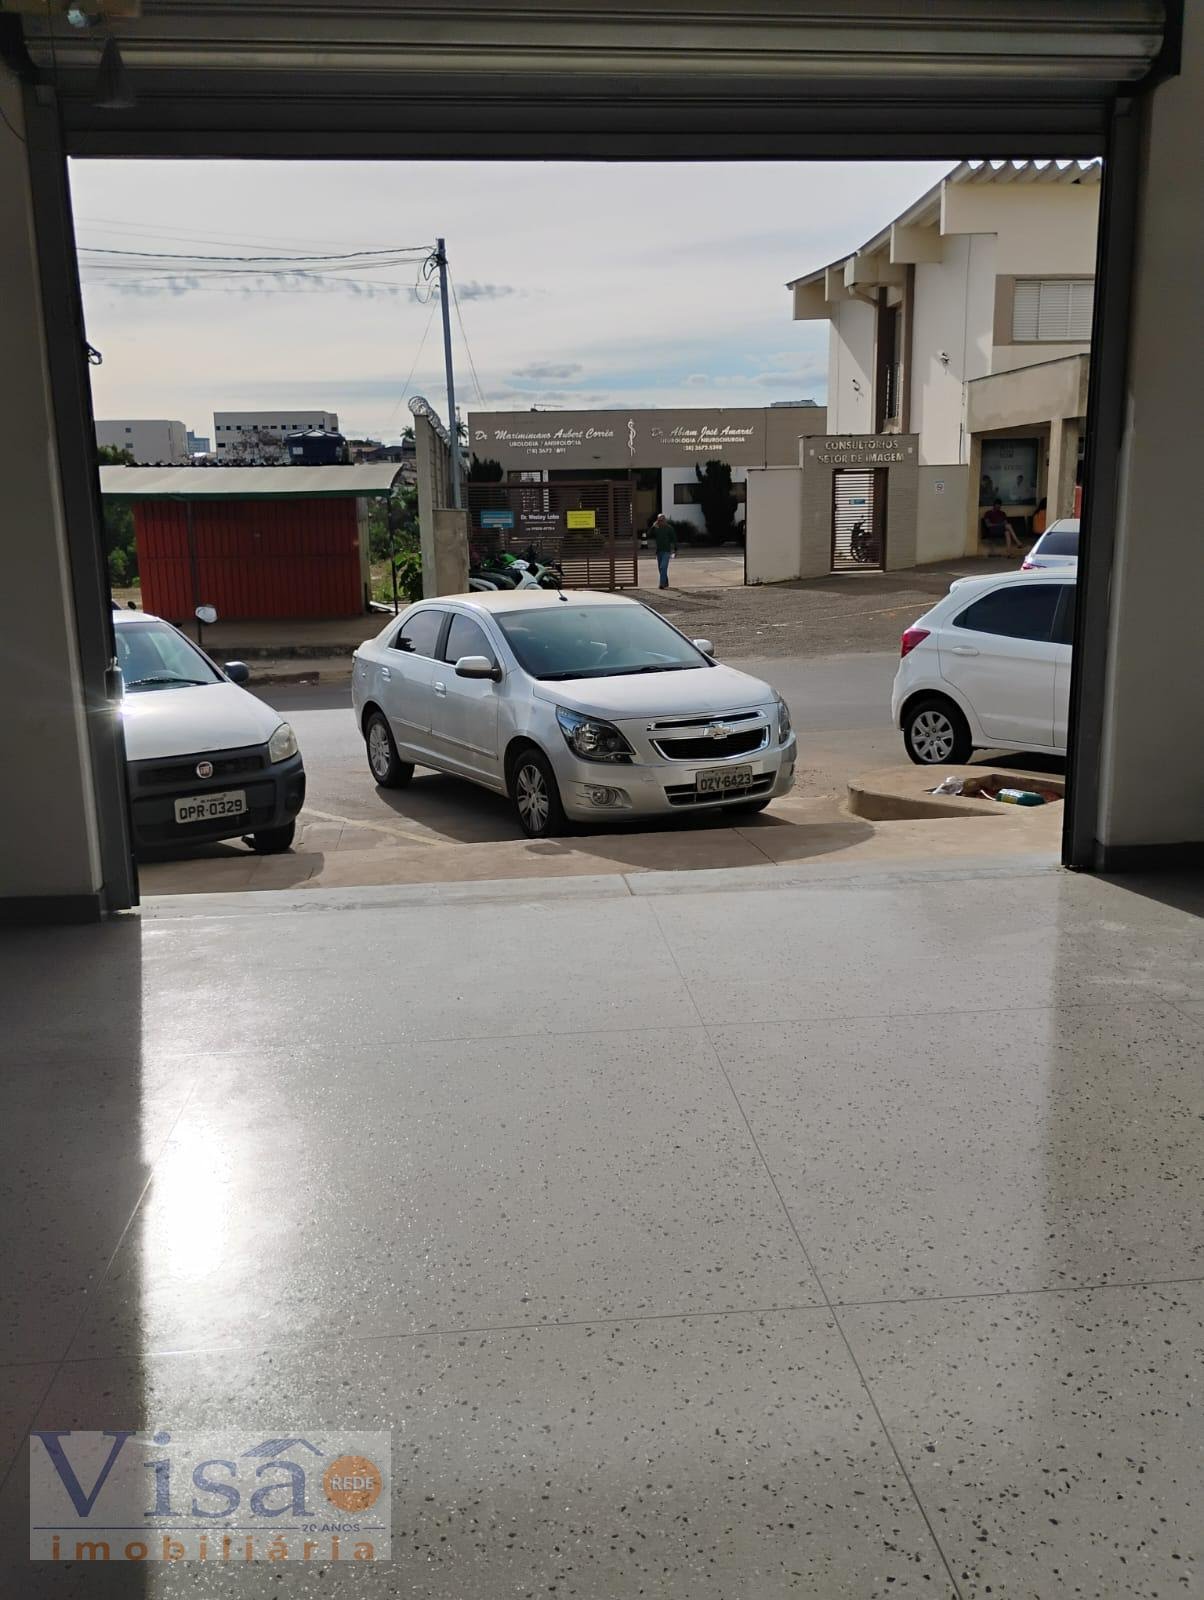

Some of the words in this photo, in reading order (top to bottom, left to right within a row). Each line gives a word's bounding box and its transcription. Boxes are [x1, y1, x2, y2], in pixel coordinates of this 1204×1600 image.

[720, 425, 754, 436] Amaral
[817, 454, 848, 464] SETOR
[850, 453, 863, 463] DE
[865, 452, 905, 462] IMAGEM
